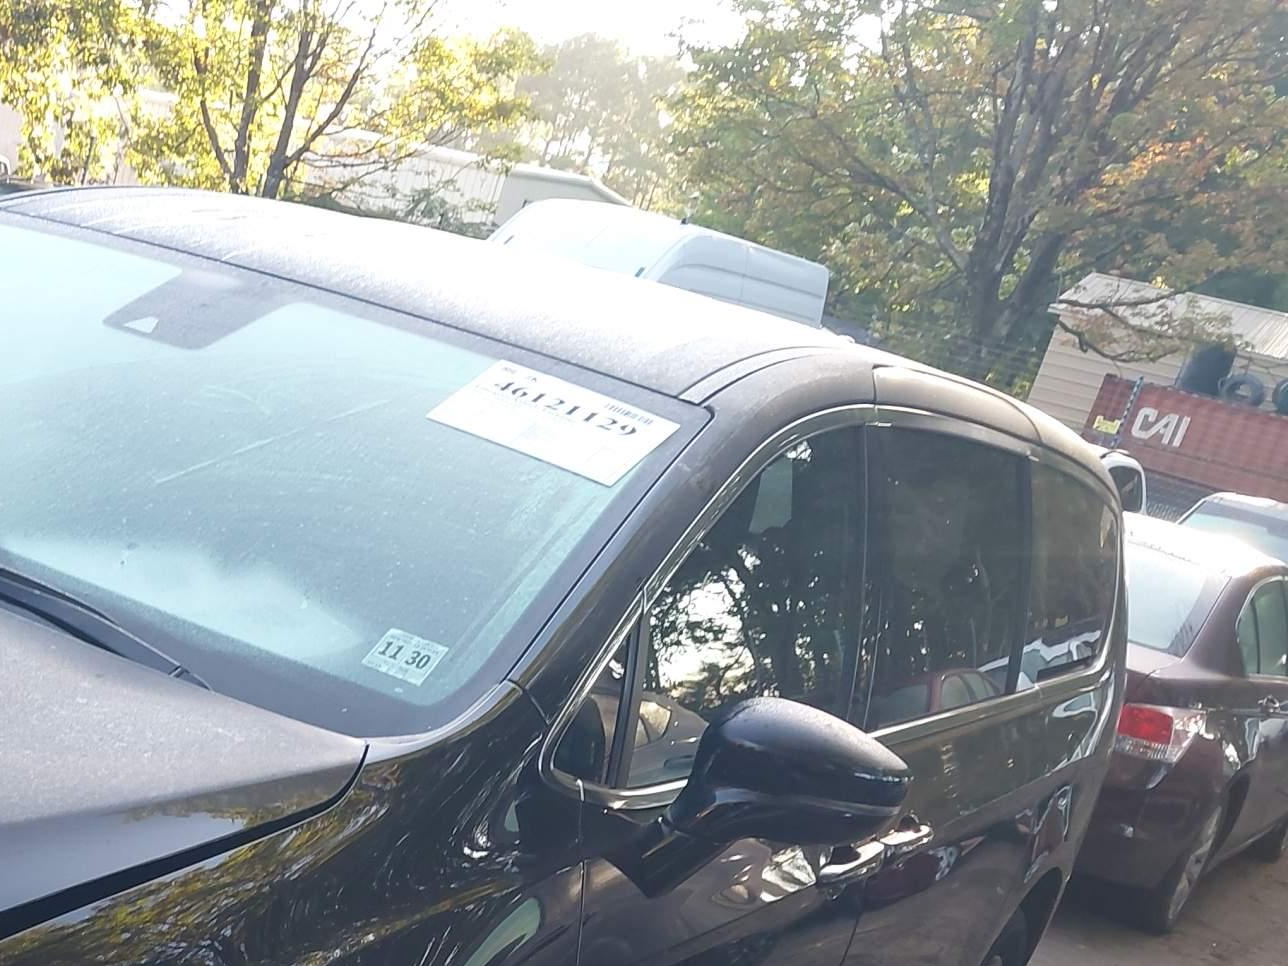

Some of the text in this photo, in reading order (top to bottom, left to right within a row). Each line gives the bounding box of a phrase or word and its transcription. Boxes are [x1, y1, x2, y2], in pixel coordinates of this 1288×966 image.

[494, 380, 638, 436] 46121129
[1131, 406, 1192, 448] CAI
[377, 640, 404, 661] 11
[404, 650, 431, 670] 30
